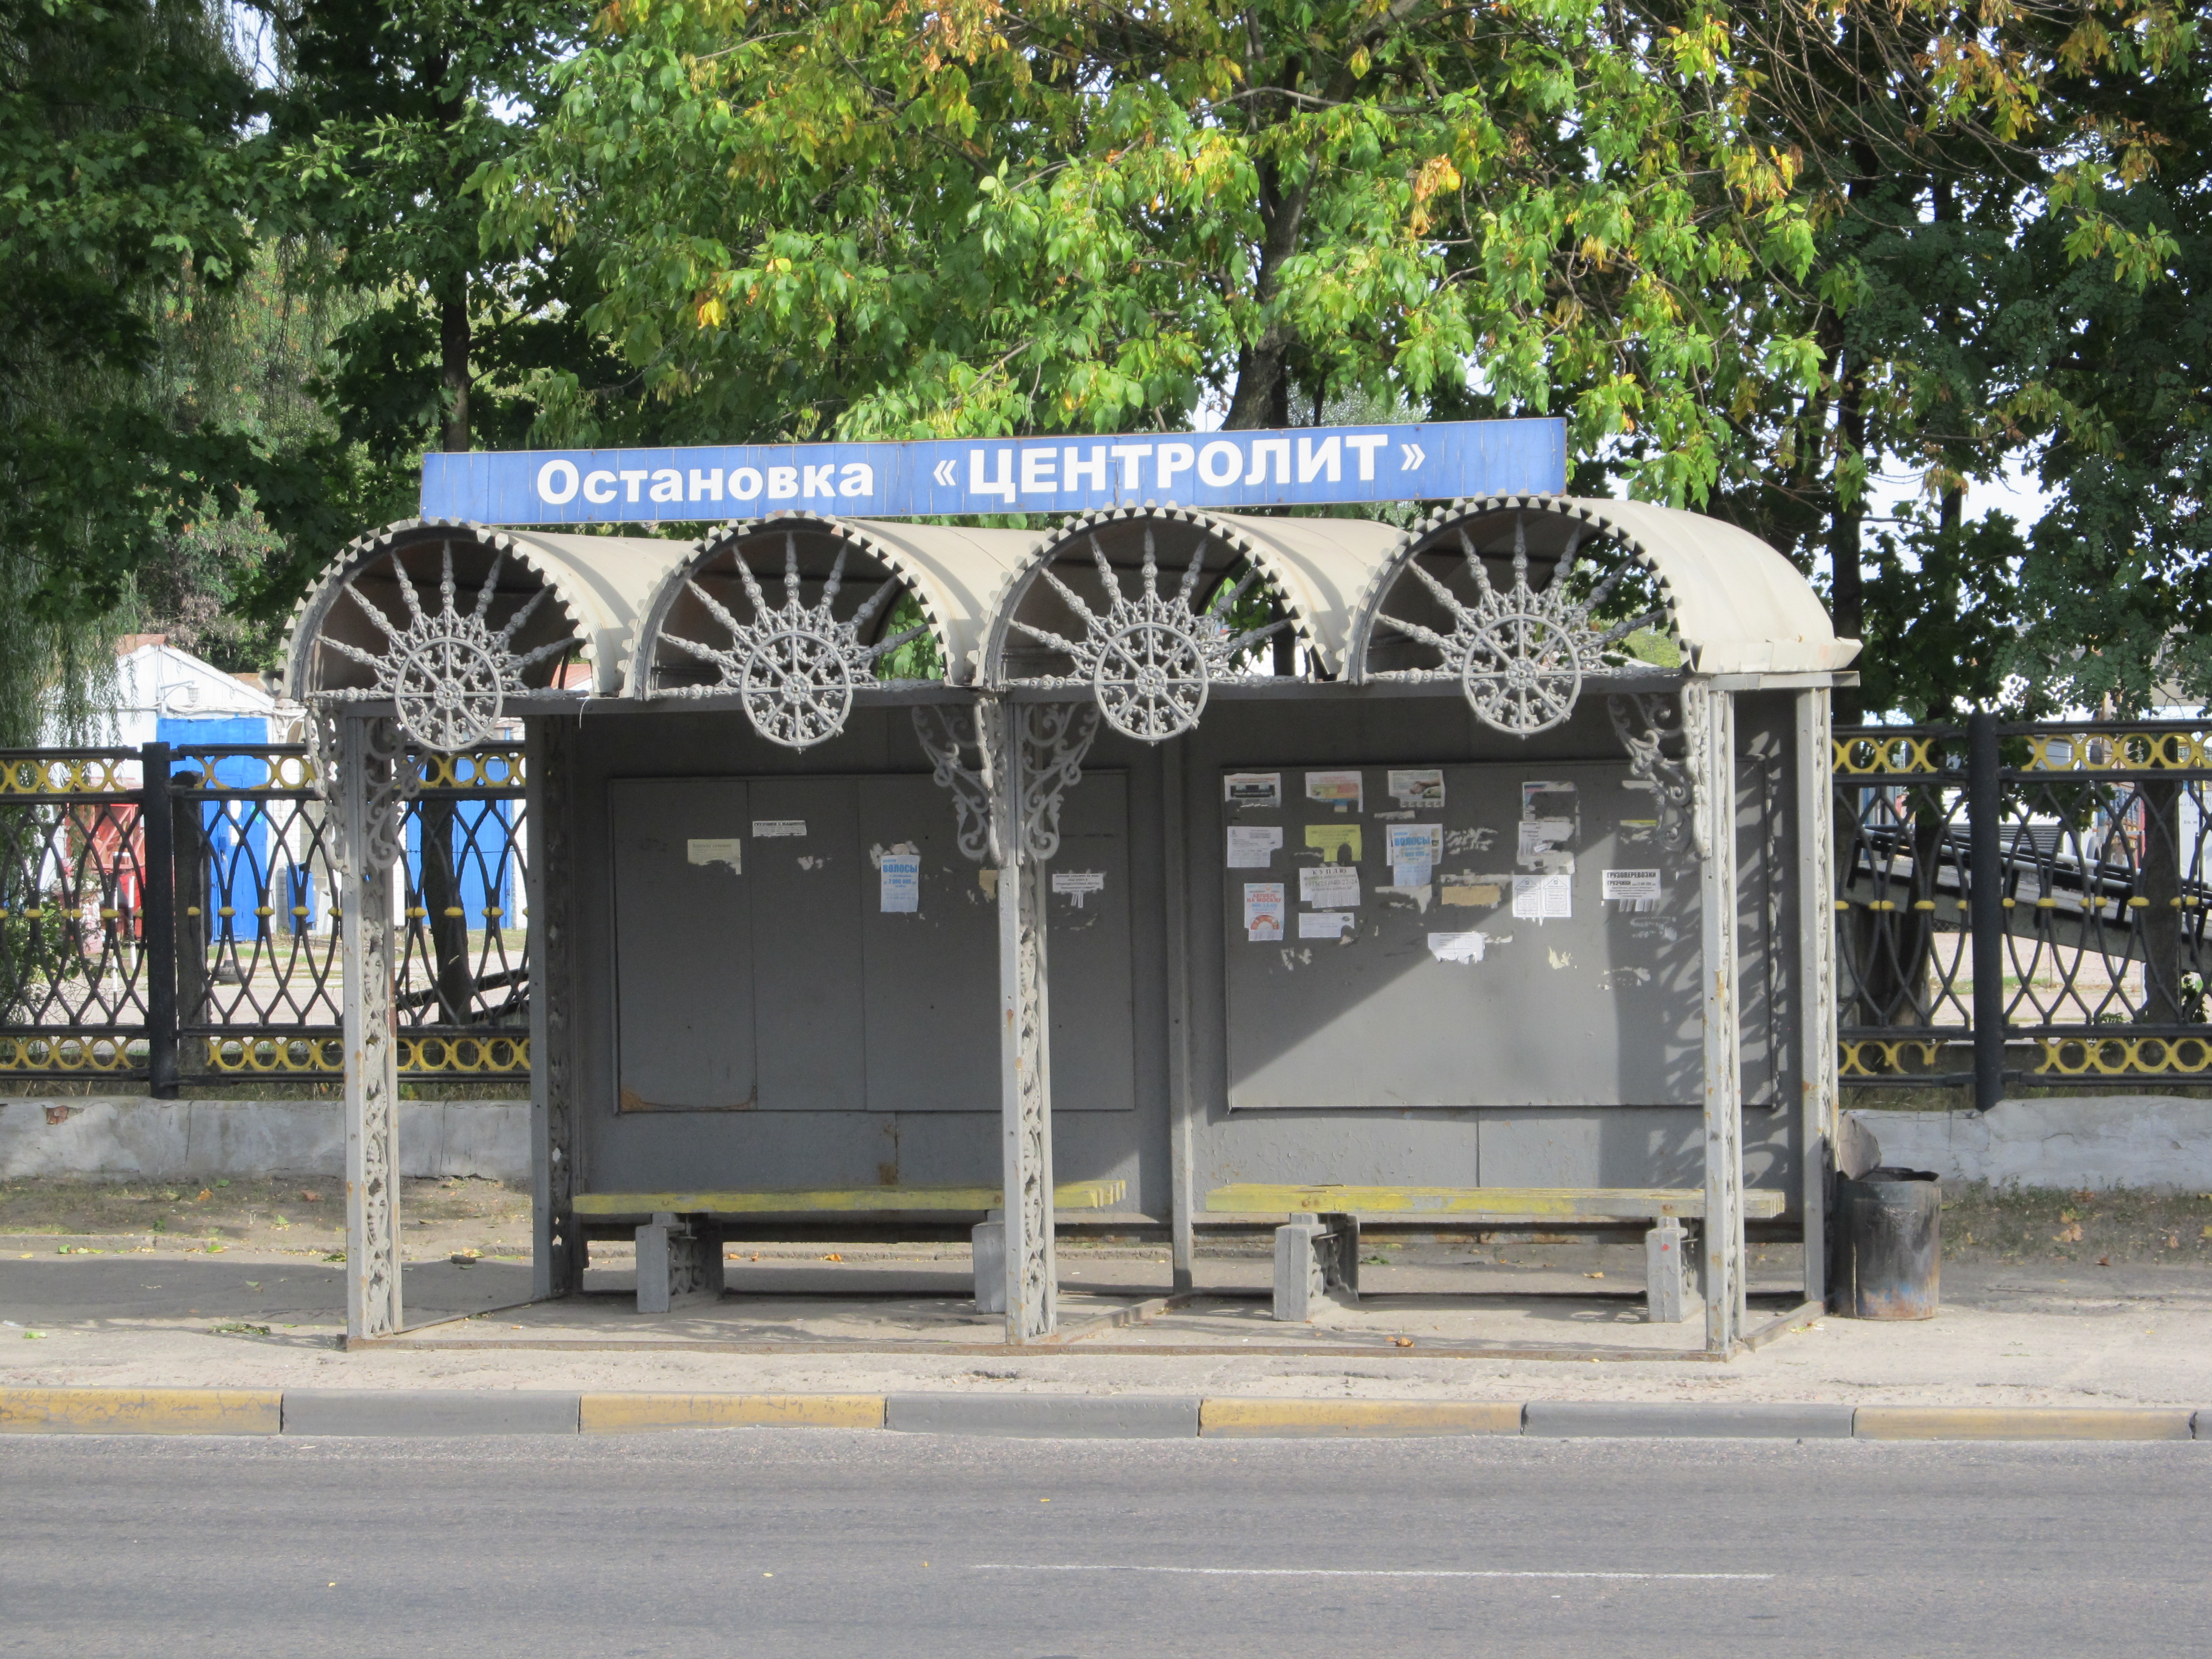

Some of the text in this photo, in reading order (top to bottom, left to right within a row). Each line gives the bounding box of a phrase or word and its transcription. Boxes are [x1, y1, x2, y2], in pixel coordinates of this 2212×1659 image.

[537, 434, 1426, 504] Остановка «ЦЕНТРОЛИТ»
[1394, 836, 1431, 846] ВОЛОСЫ
[883, 864, 917, 873] ВОЛОСЫ
